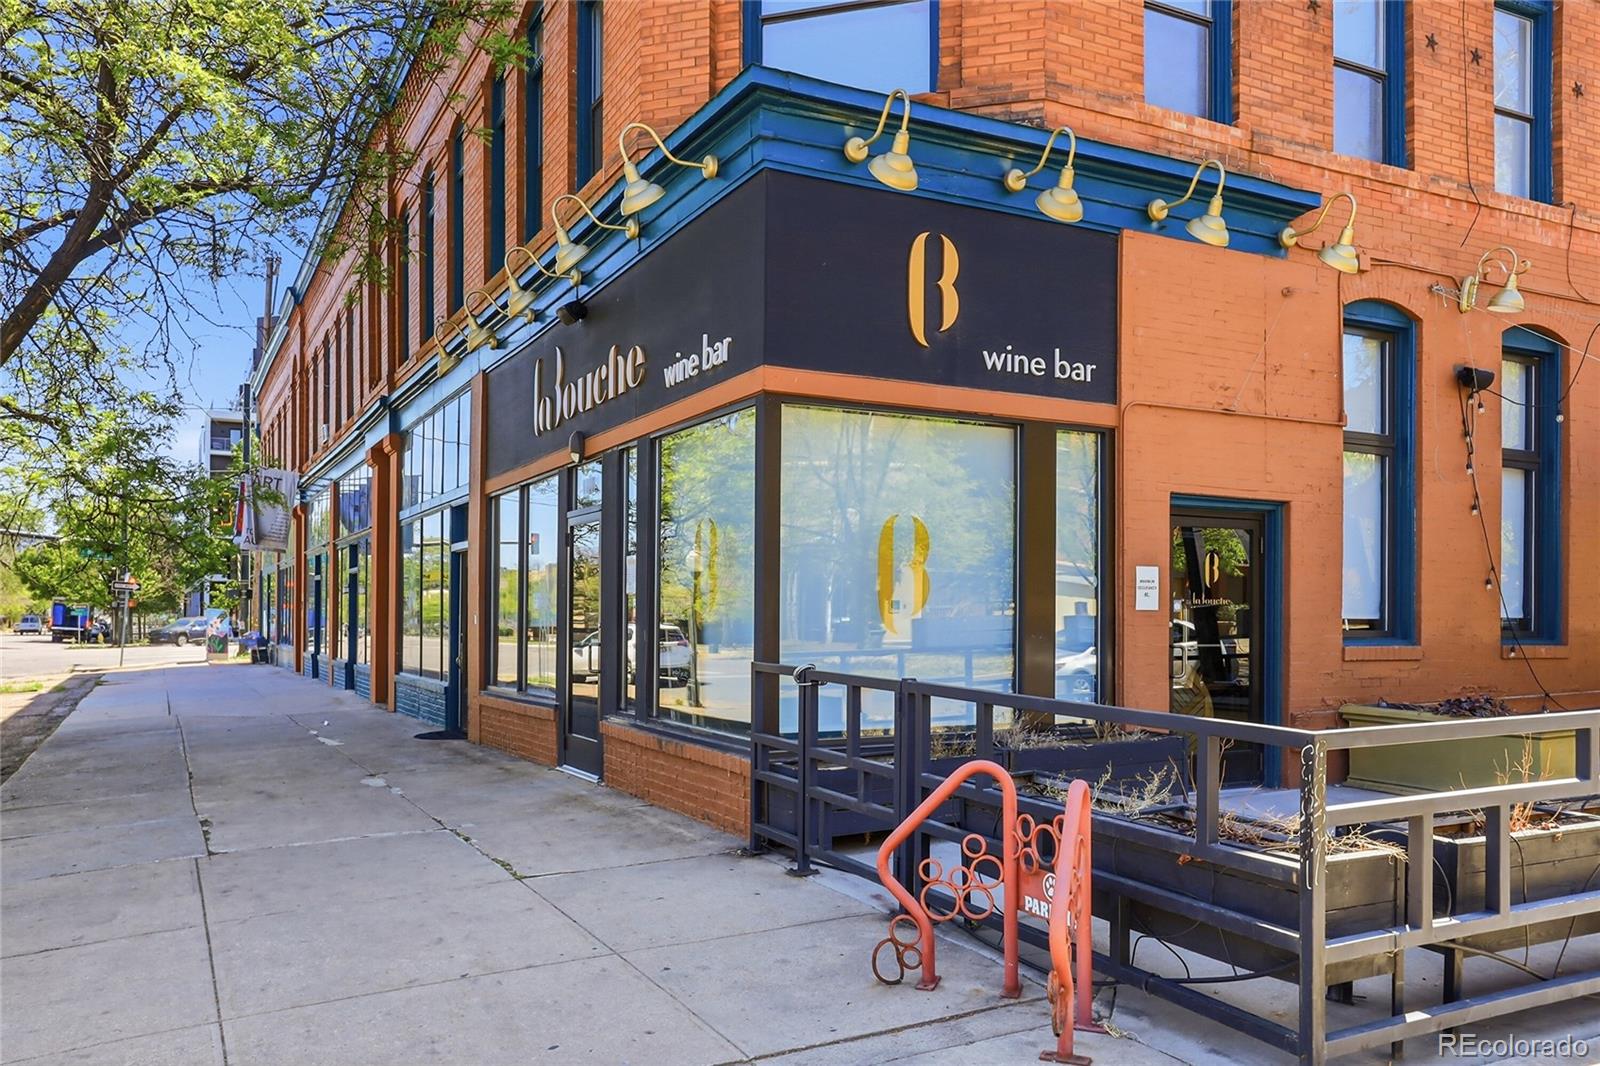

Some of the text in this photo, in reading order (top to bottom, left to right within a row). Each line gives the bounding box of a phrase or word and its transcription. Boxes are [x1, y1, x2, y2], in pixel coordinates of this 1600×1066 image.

[663, 334, 732, 389] wine bar
[982, 345, 1097, 382] wine bar
